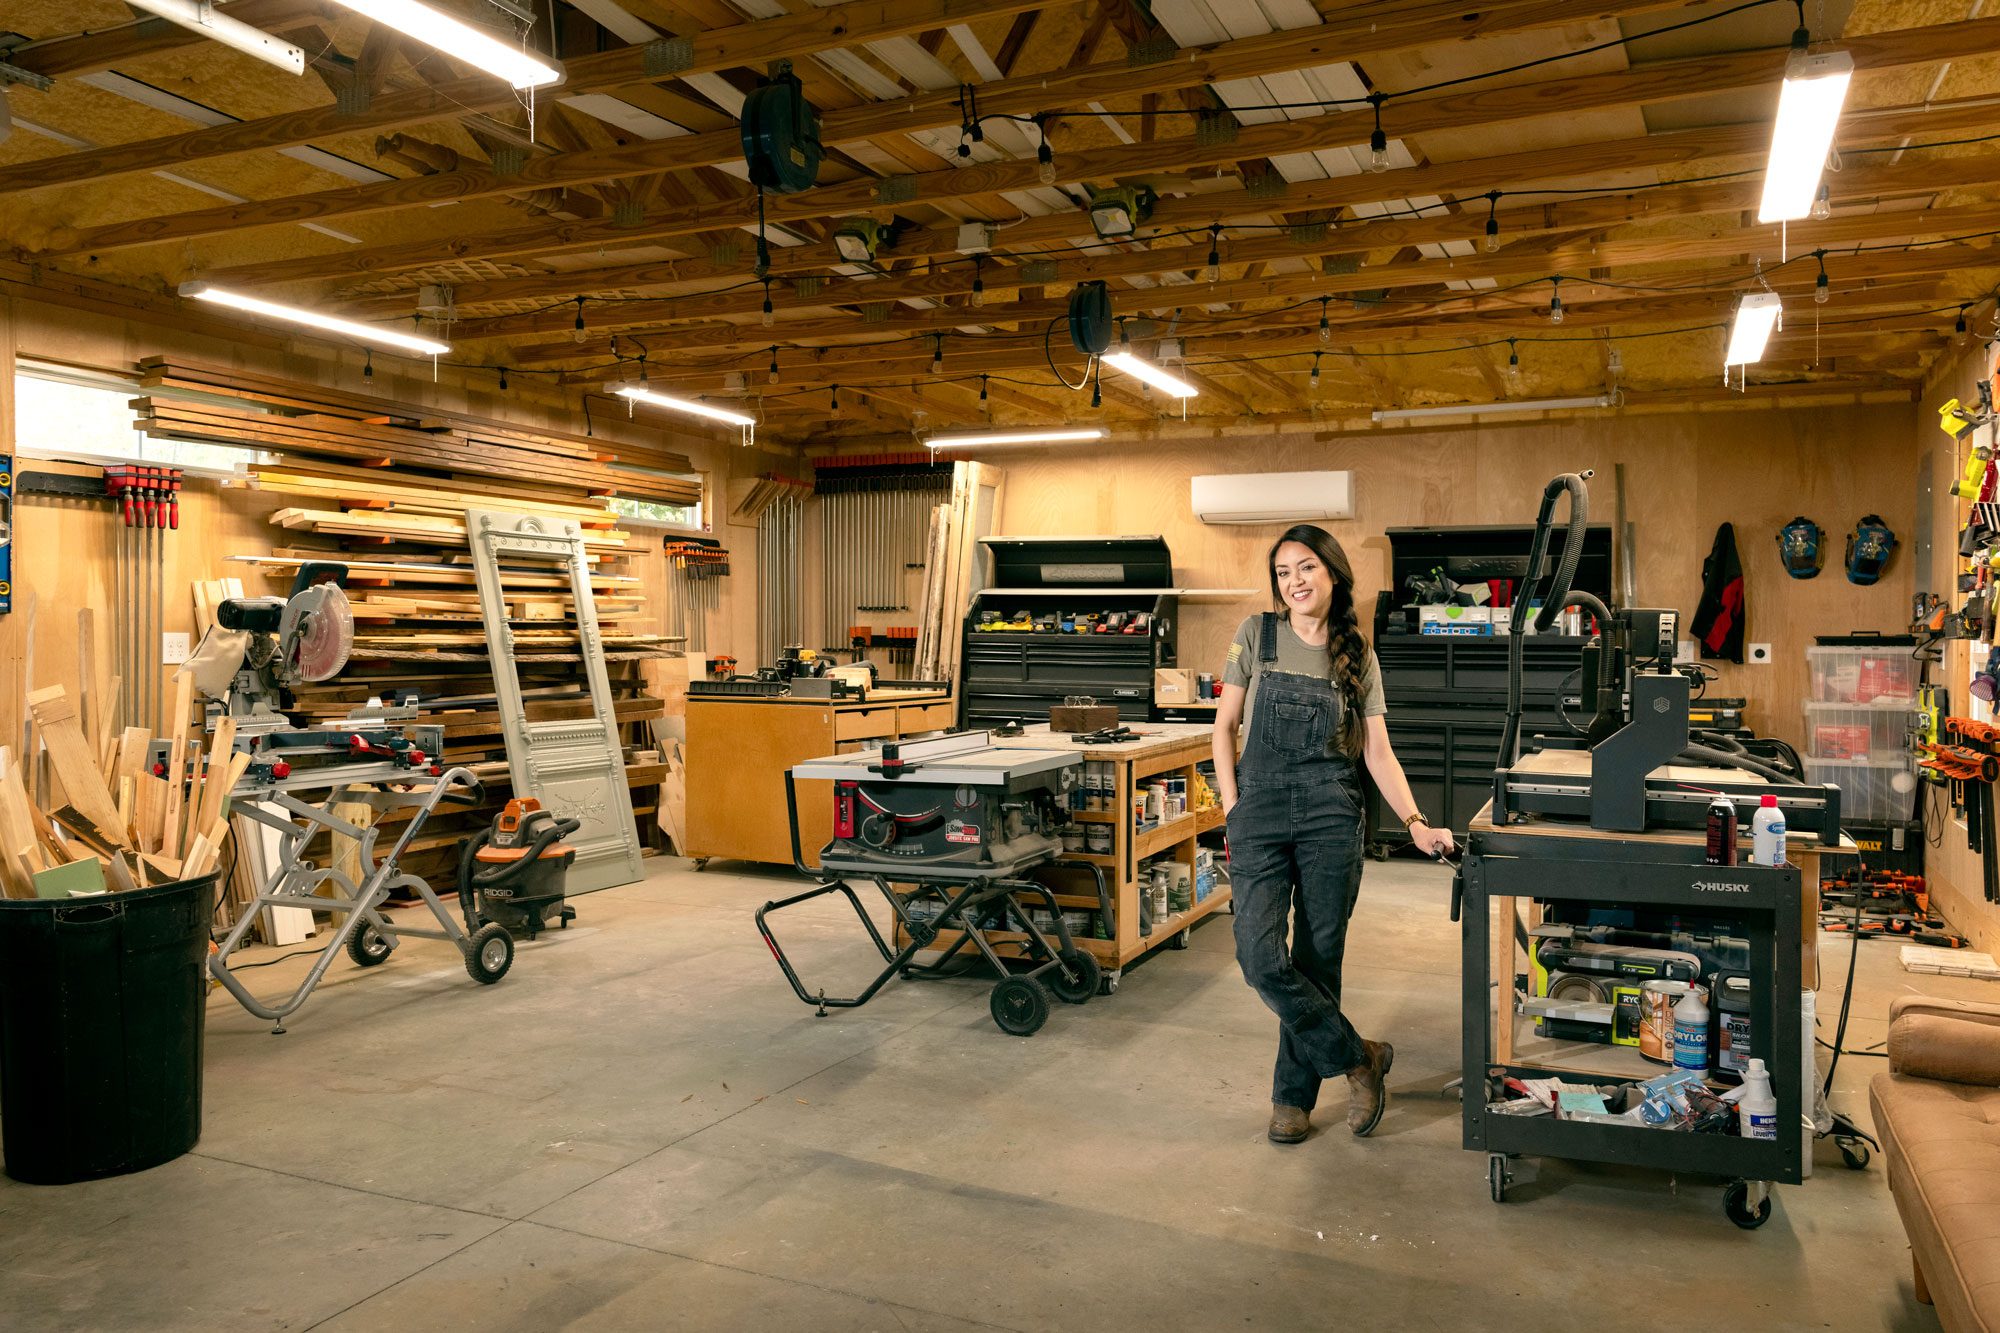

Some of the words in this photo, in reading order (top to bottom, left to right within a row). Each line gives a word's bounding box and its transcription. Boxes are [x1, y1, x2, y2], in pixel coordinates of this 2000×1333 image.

[1067, 567, 1115, 579] HUSKY
[1856, 840, 1882, 851] WALT
[484, 888, 513, 897] RIDGID
[1707, 882, 1749, 893] HUSKY
[1623, 996, 1639, 1004] RYO
[1727, 1022, 1750, 1033] DRY
